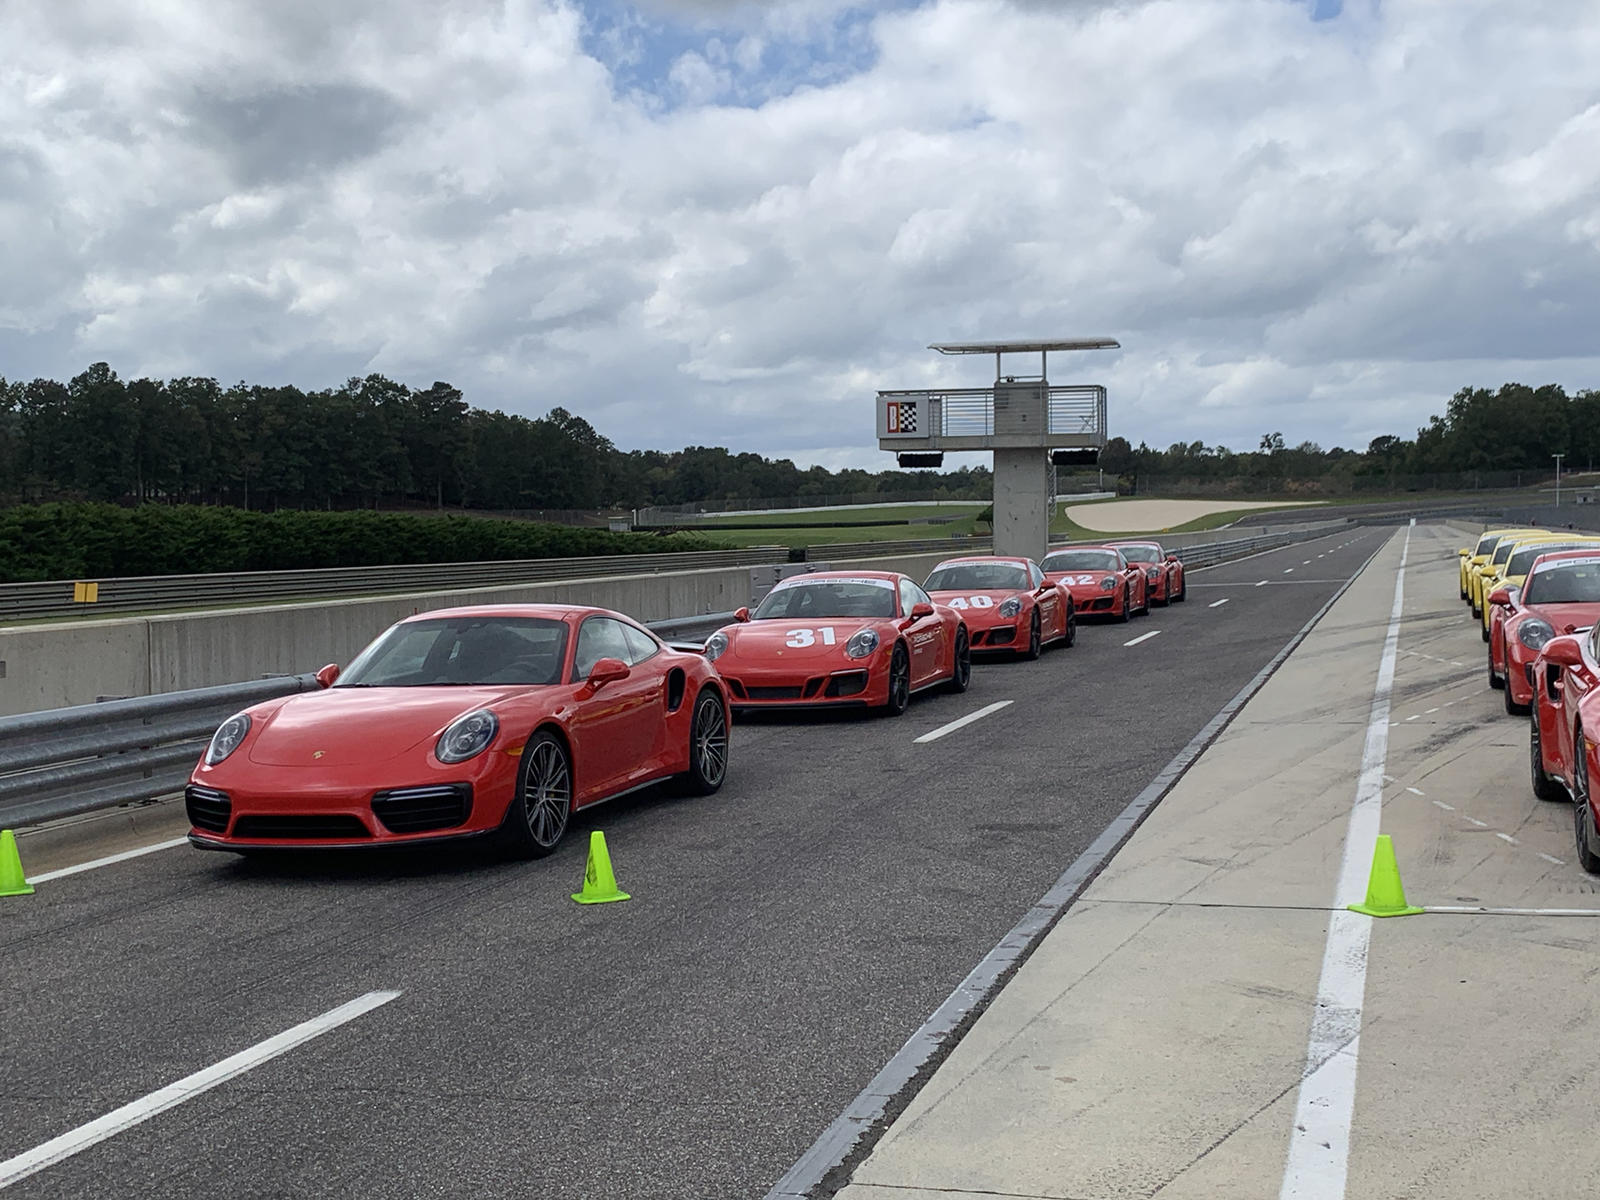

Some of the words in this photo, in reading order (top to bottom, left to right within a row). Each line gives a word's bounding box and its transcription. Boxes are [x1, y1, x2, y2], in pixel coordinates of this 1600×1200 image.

[1058, 575, 1096, 586] 42
[947, 595, 994, 610] 40
[785, 627, 836, 648] 31
